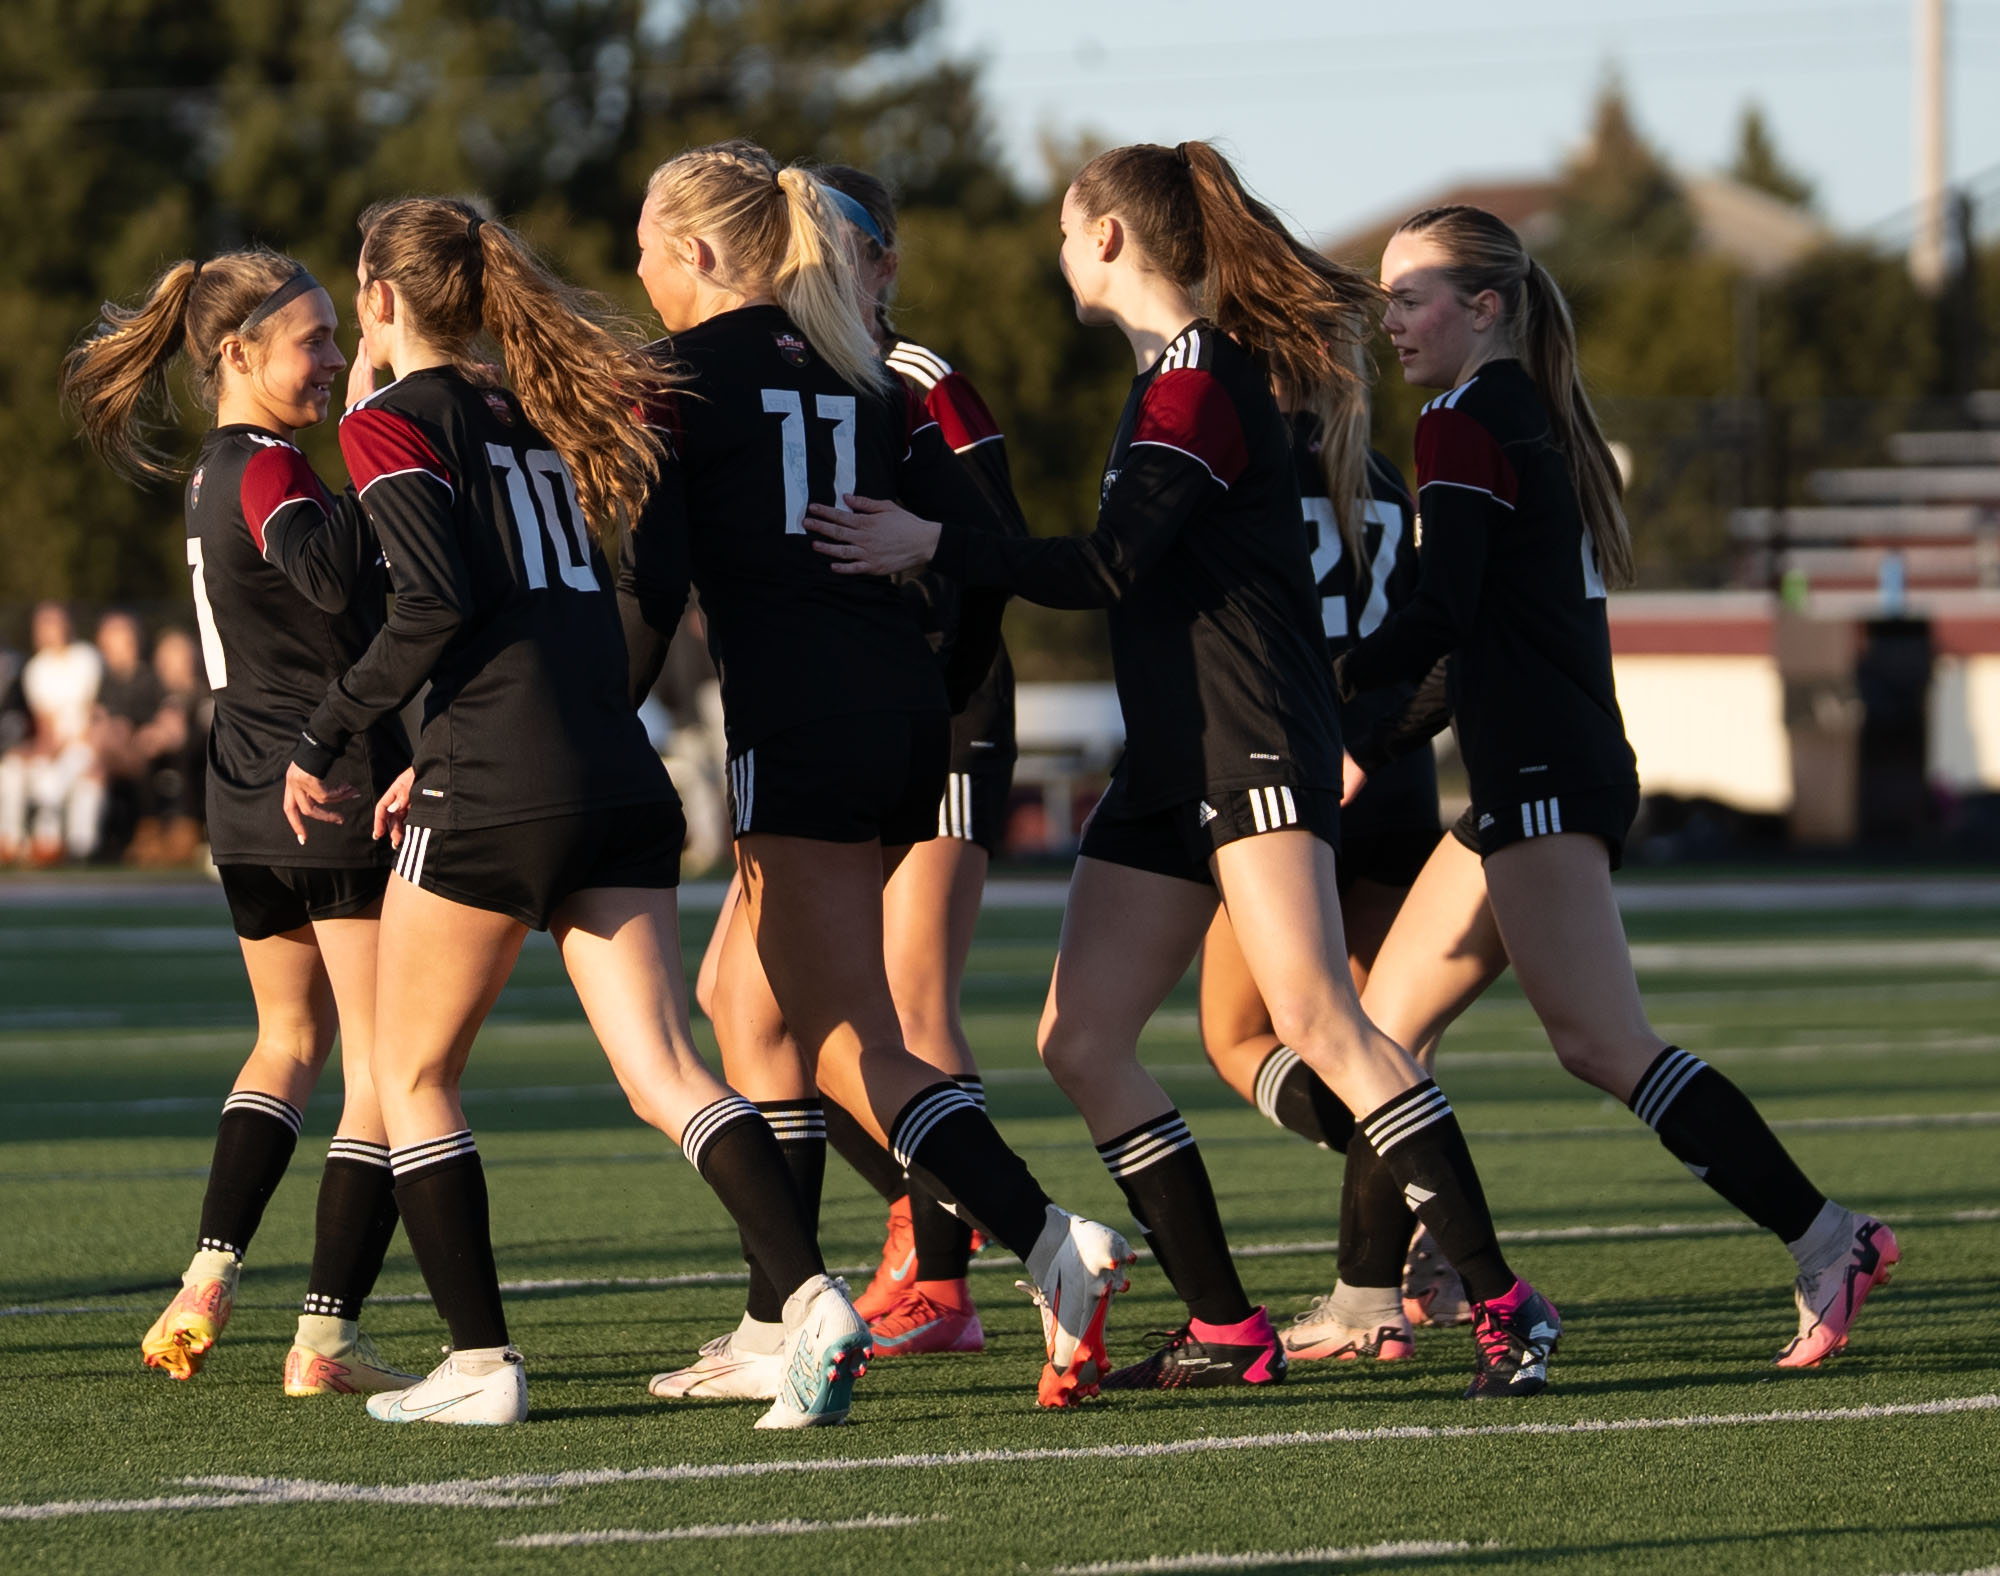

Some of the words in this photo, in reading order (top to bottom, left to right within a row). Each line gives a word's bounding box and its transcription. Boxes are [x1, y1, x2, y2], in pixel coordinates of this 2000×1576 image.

[485, 442, 600, 591] 10
[761, 388, 856, 534] 11
[1301, 497, 1403, 639] 27
